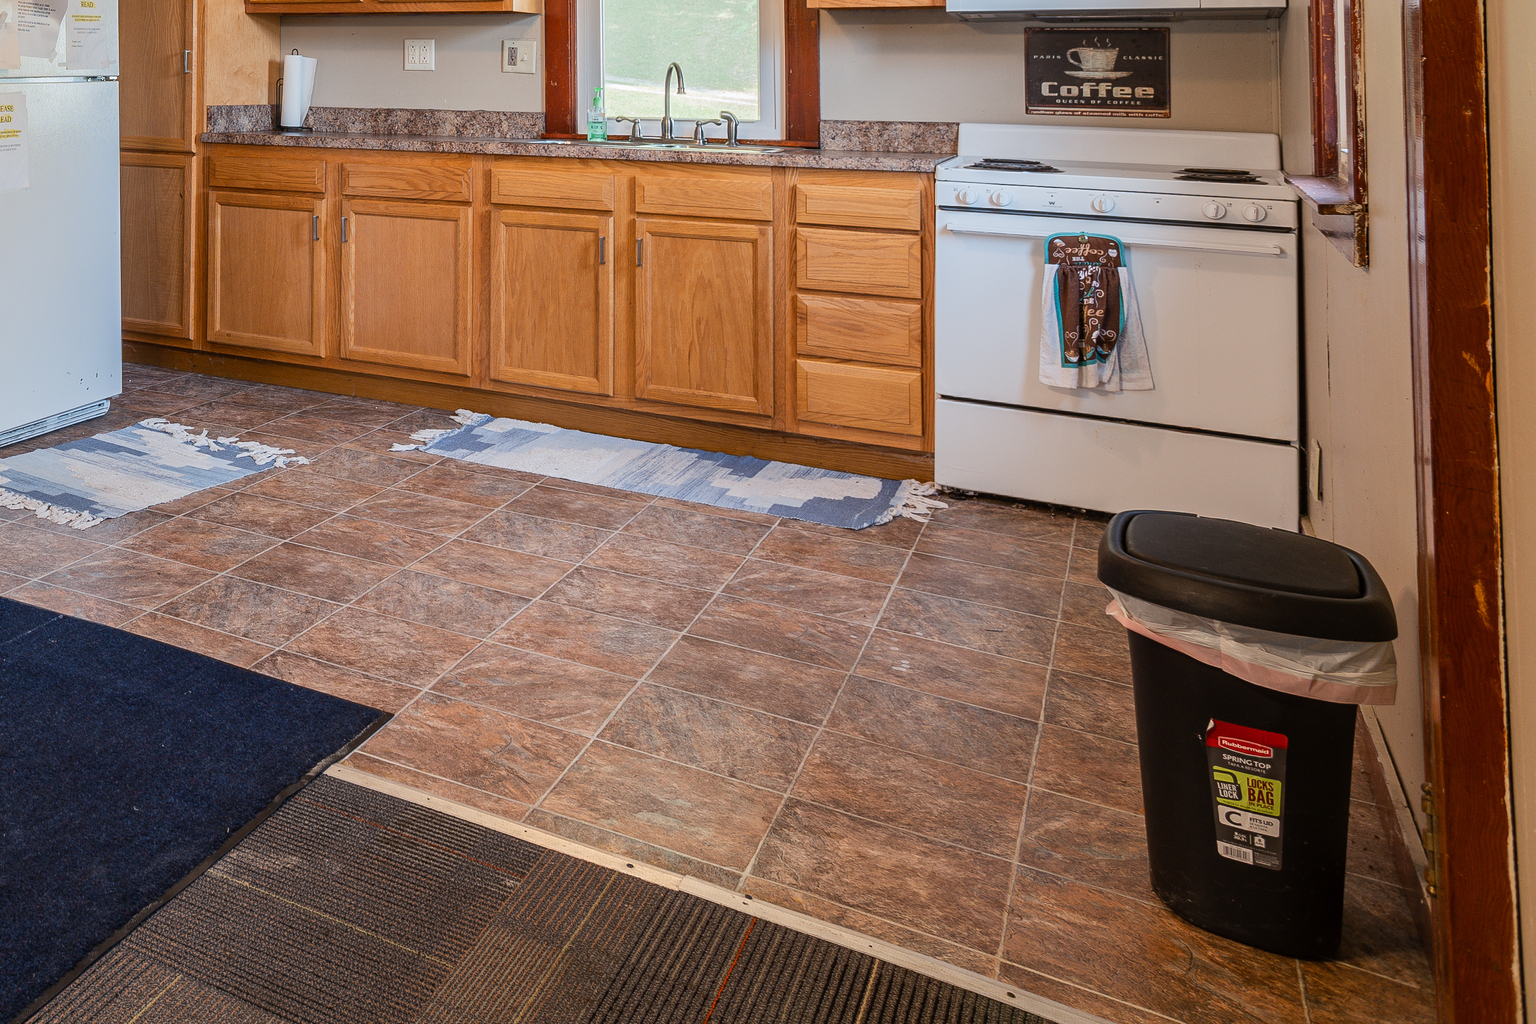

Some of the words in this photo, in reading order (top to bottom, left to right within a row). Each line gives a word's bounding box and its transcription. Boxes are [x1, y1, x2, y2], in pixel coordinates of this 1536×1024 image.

[1041, 81, 1154, 98] Coffee
[1064, 243, 1104, 256] coffee
[1222, 740, 1269, 755] Rubbermaid
[1222, 753, 1253, 766] SPRING
[1253, 760, 1271, 770] TOP
[1217, 782, 1237, 791] LINER
[1247, 777, 1274, 791] LOCKS
[1219, 789, 1239, 799] LOCK
[1248, 788, 1274, 805] BAG
[1256, 802, 1274, 810] PLACE
[1225, 811, 1242, 826] C
